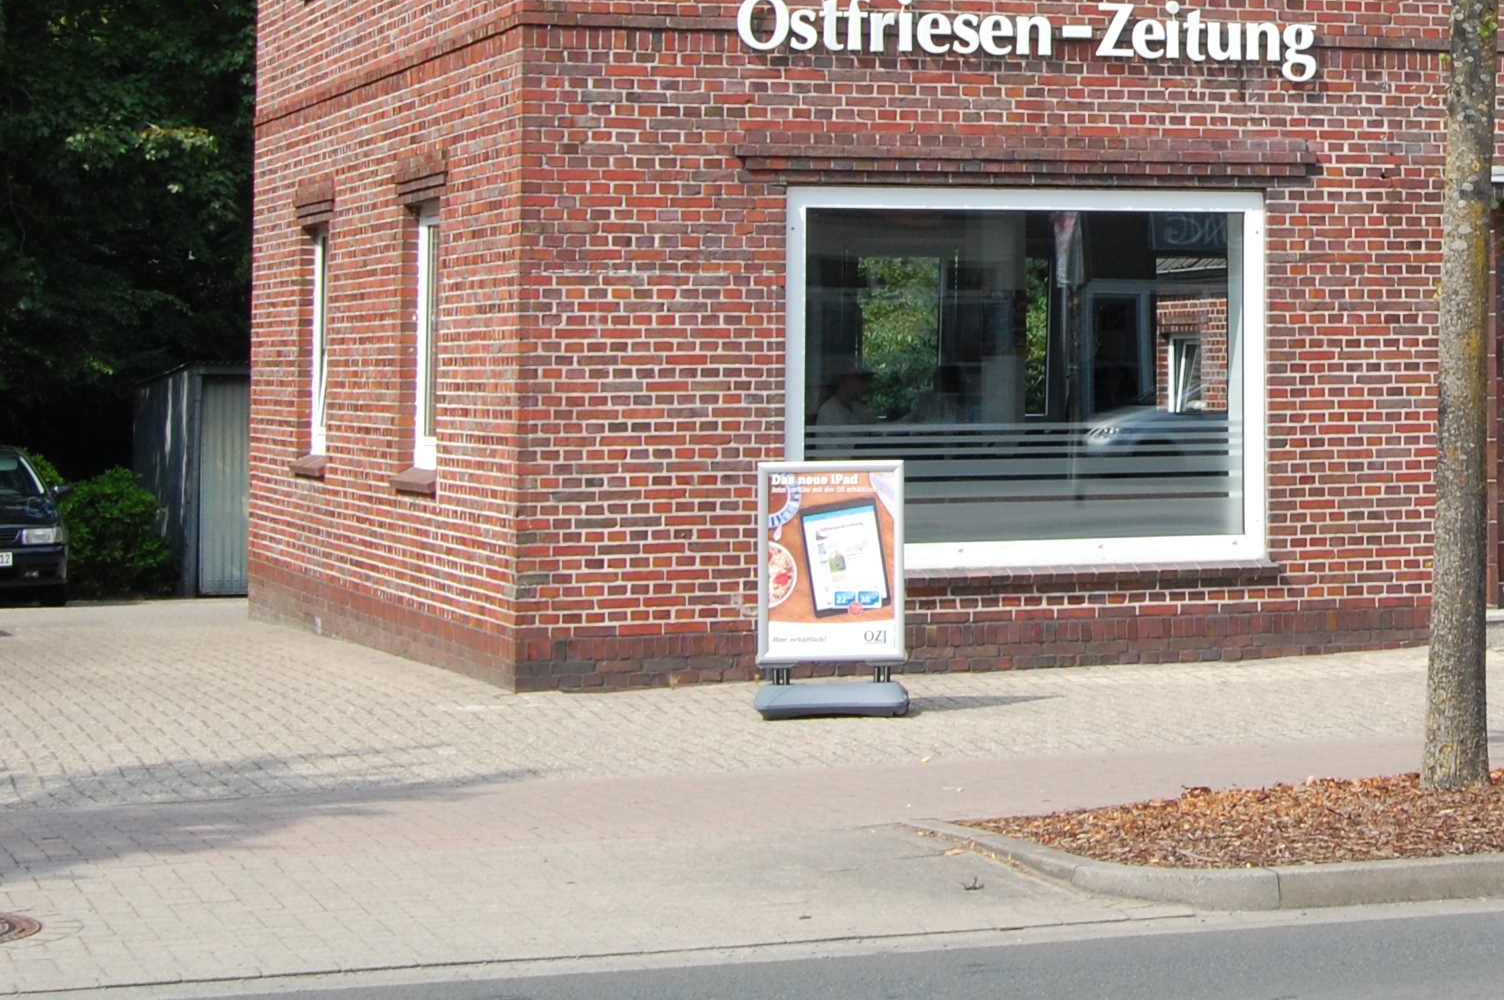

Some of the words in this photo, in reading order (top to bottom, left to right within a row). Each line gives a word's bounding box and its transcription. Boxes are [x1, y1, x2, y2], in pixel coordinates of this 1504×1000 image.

[771, 474, 795, 485] Das
[798, 476, 828, 485] neue
[831, 473, 858, 485] iPad
